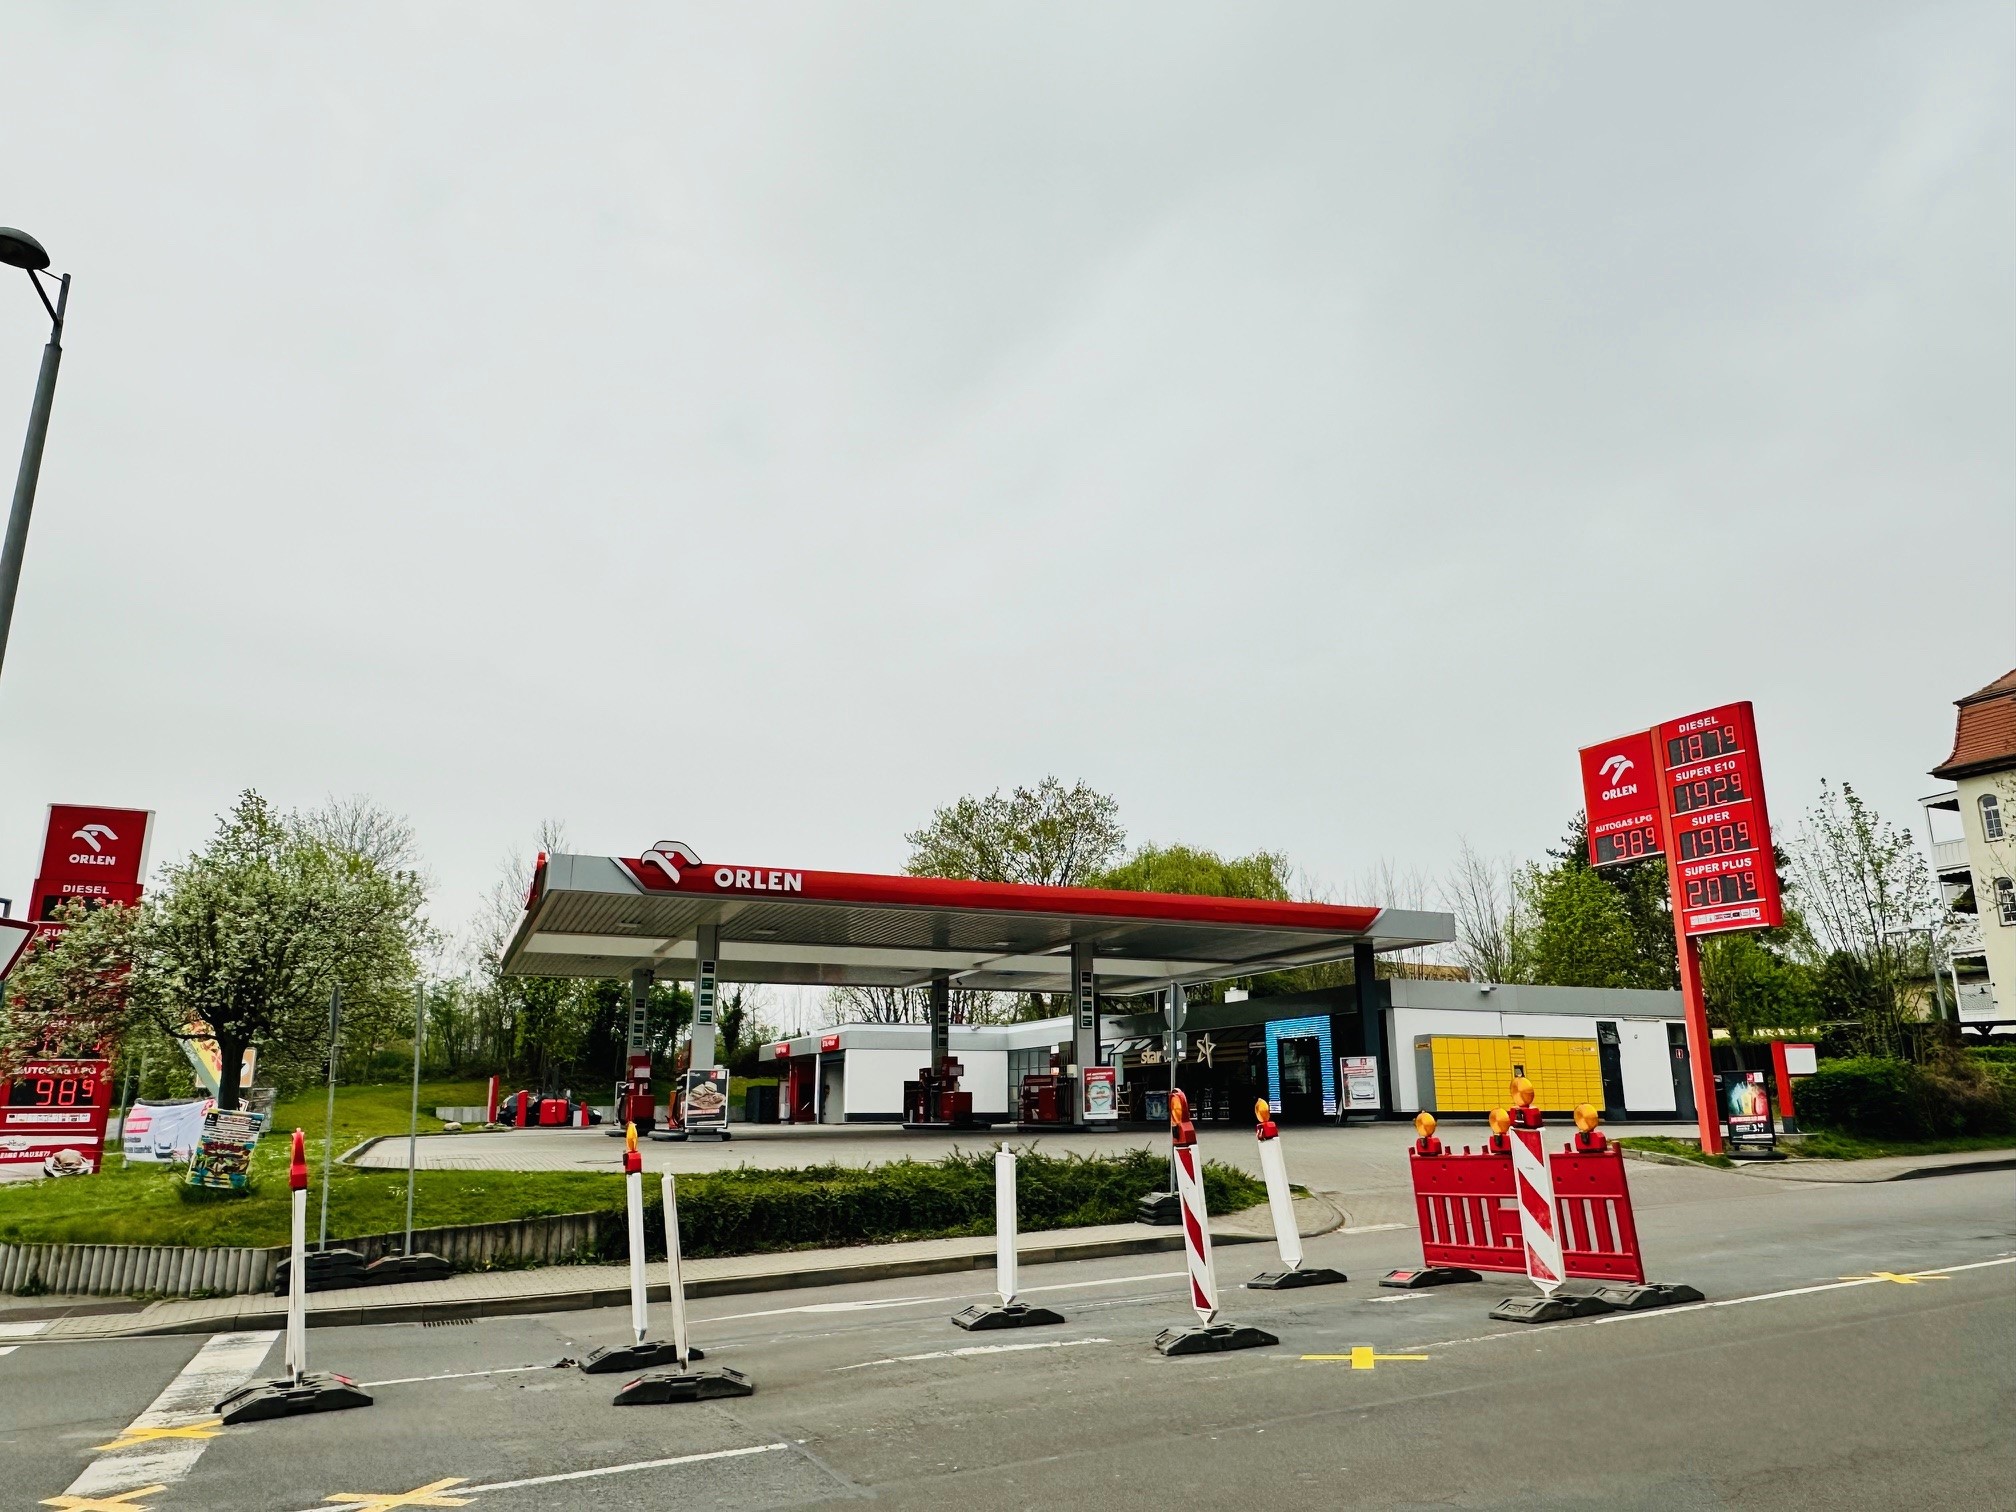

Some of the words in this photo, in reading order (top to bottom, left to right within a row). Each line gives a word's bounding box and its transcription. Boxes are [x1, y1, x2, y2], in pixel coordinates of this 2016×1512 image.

[1678, 716, 1719, 733] DIESEL
[1675, 765, 1712, 782] SUPER
[1714, 760, 1736, 774] E10
[1602, 783, 1638, 801] ORLEN
[1595, 818, 1633, 833] AUTOGAS
[1634, 814, 1653, 824] LPG
[1691, 811, 1730, 826] SUPER
[69, 853, 116, 866] ORLEN
[1685, 862, 1720, 877] SUPER
[1721, 857, 1752, 871] PLUS
[714, 868, 802, 892] ORLEN
[62, 884, 110, 895] DIESEL
